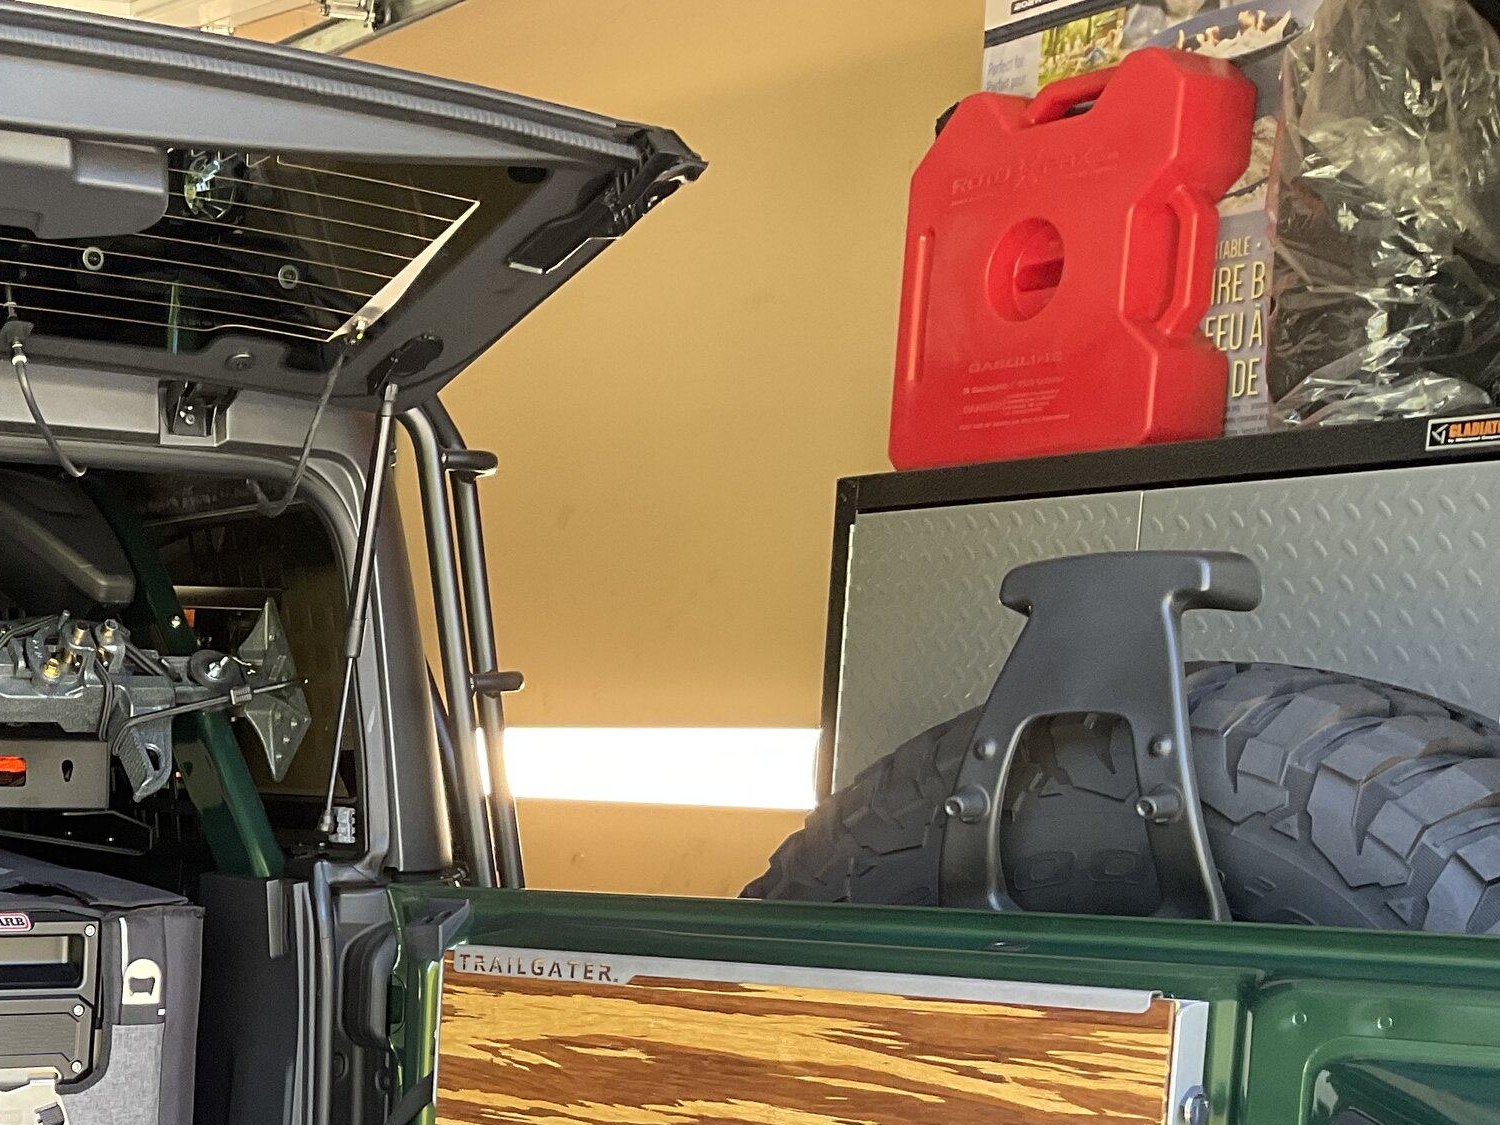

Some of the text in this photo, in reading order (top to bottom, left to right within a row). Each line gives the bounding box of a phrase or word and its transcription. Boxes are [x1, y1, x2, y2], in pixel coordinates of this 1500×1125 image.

[1211, 260, 1266, 306] IRE B
[1231, 357, 1261, 398] DE
[459, 953, 613, 982] TRAILGATER
